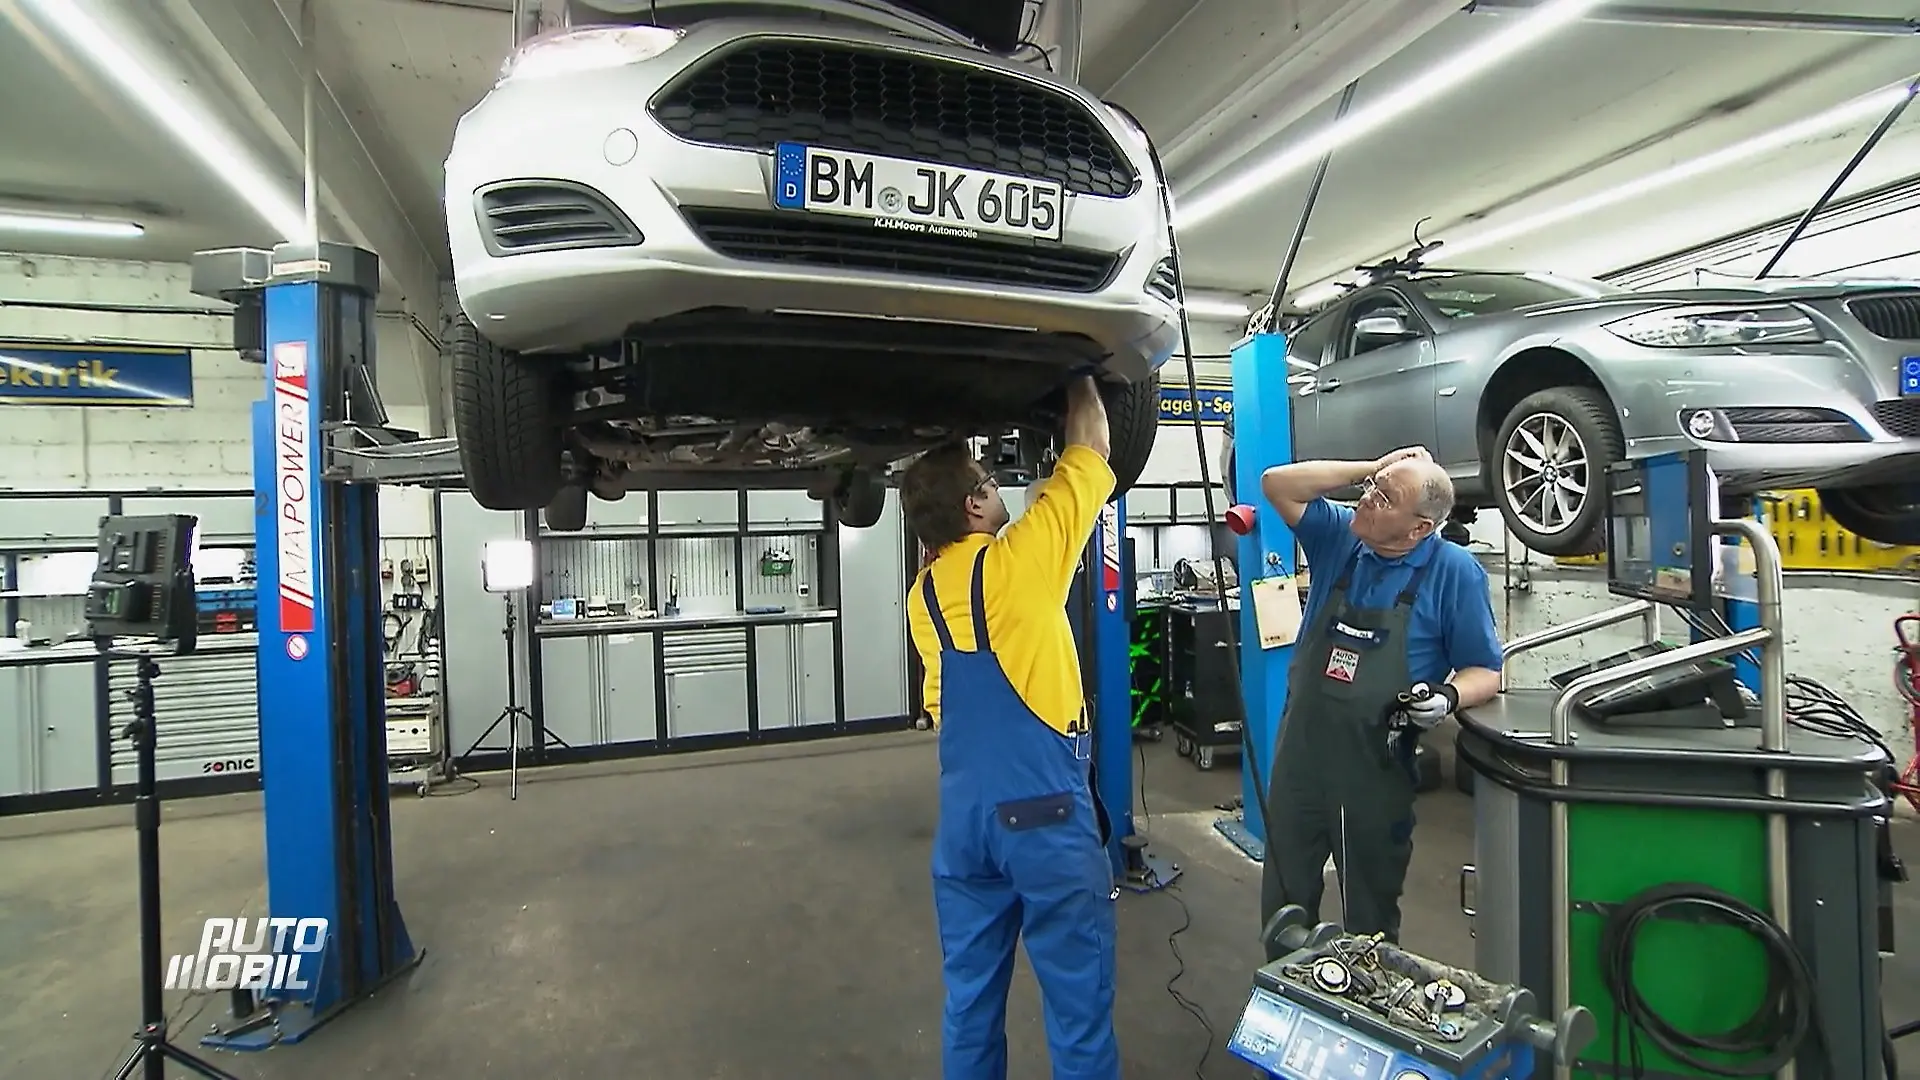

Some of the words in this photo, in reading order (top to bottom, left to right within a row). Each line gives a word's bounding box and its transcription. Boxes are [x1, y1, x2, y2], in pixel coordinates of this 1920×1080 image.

[786, 183, 797, 198] D
[809, 154, 873, 208] BM
[907, 168, 966, 220] JK
[977, 178, 1055, 230] 605
[928, 224, 978, 239] Automobile
[0, 360, 119, 388] ktrik
[281, 403, 308, 585] MAPOWER
